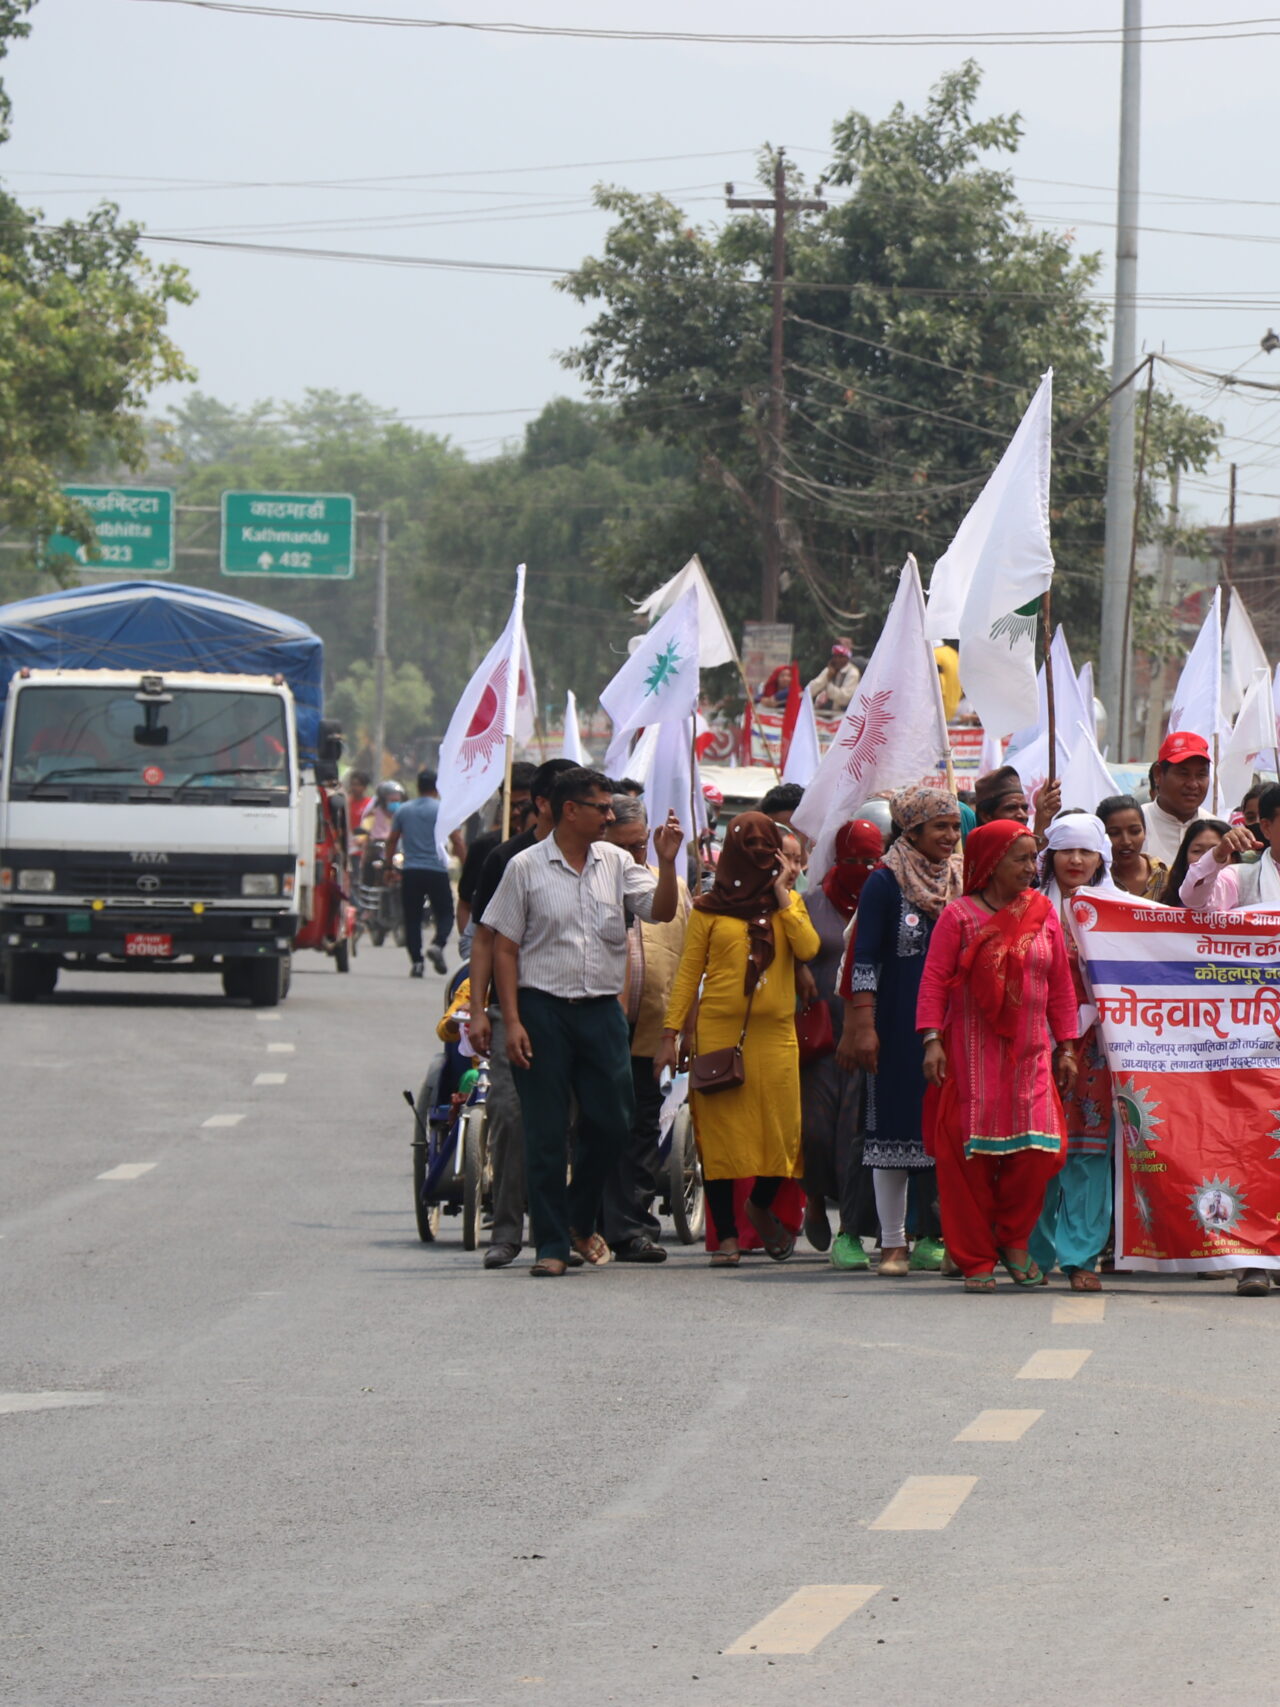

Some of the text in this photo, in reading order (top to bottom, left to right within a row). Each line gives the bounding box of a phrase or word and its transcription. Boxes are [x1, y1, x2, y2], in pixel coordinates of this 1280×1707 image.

[242, 527, 330, 544] Kathmandu
[130, 852, 168, 864] TATA
[1197, 935, 1251, 958] नेपाल
[1194, 963, 1263, 985] कोहलपुर
